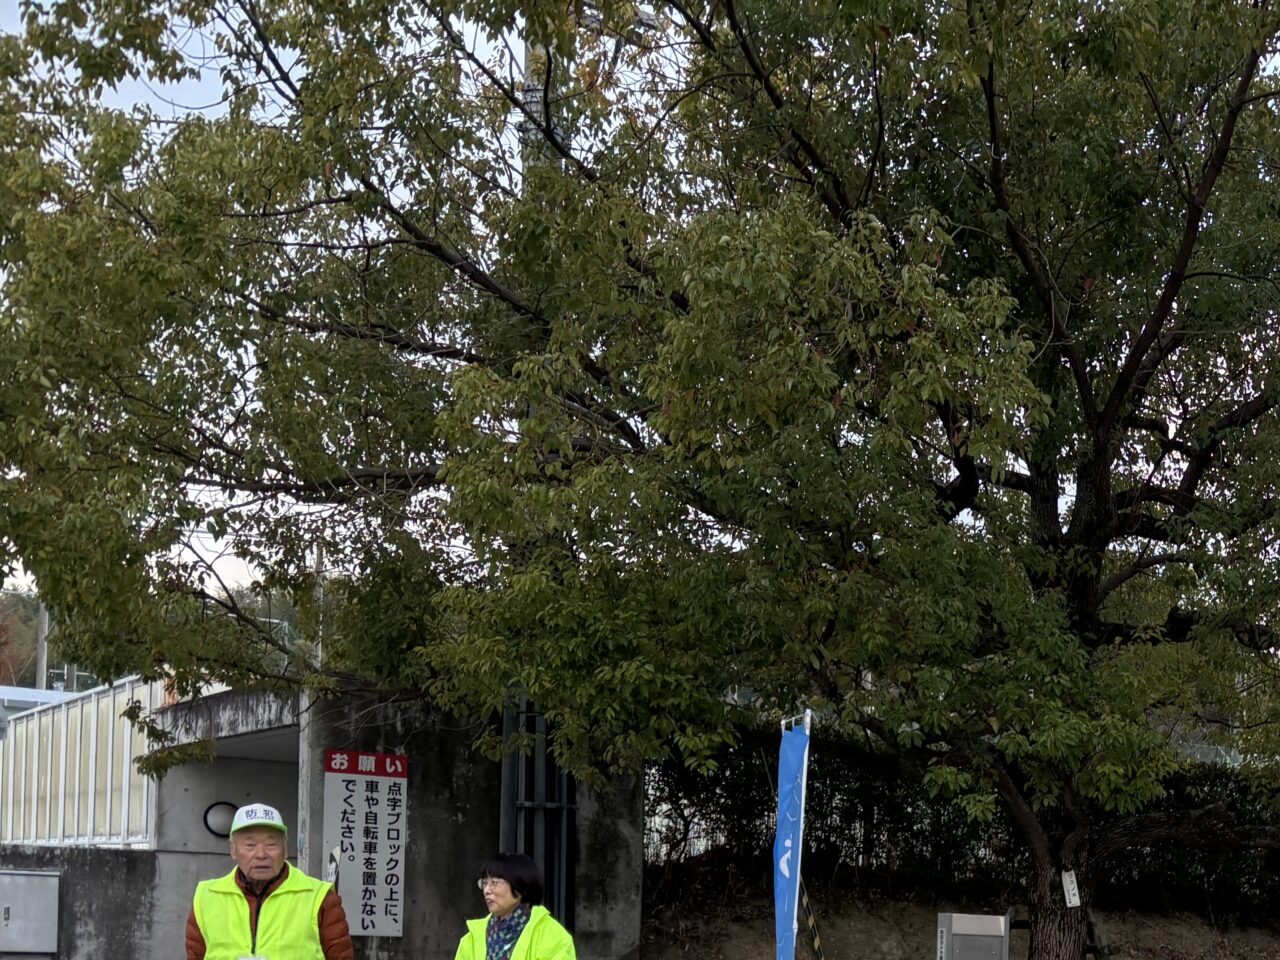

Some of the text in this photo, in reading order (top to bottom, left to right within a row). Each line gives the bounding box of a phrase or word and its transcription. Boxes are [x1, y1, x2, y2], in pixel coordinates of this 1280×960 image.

[331, 753, 403, 773] お願い
[340, 779, 357, 862] でください。
[361, 780, 379, 931] 車や自転車を置かない
[384, 781, 402, 925] 点字ブロックの上に、
